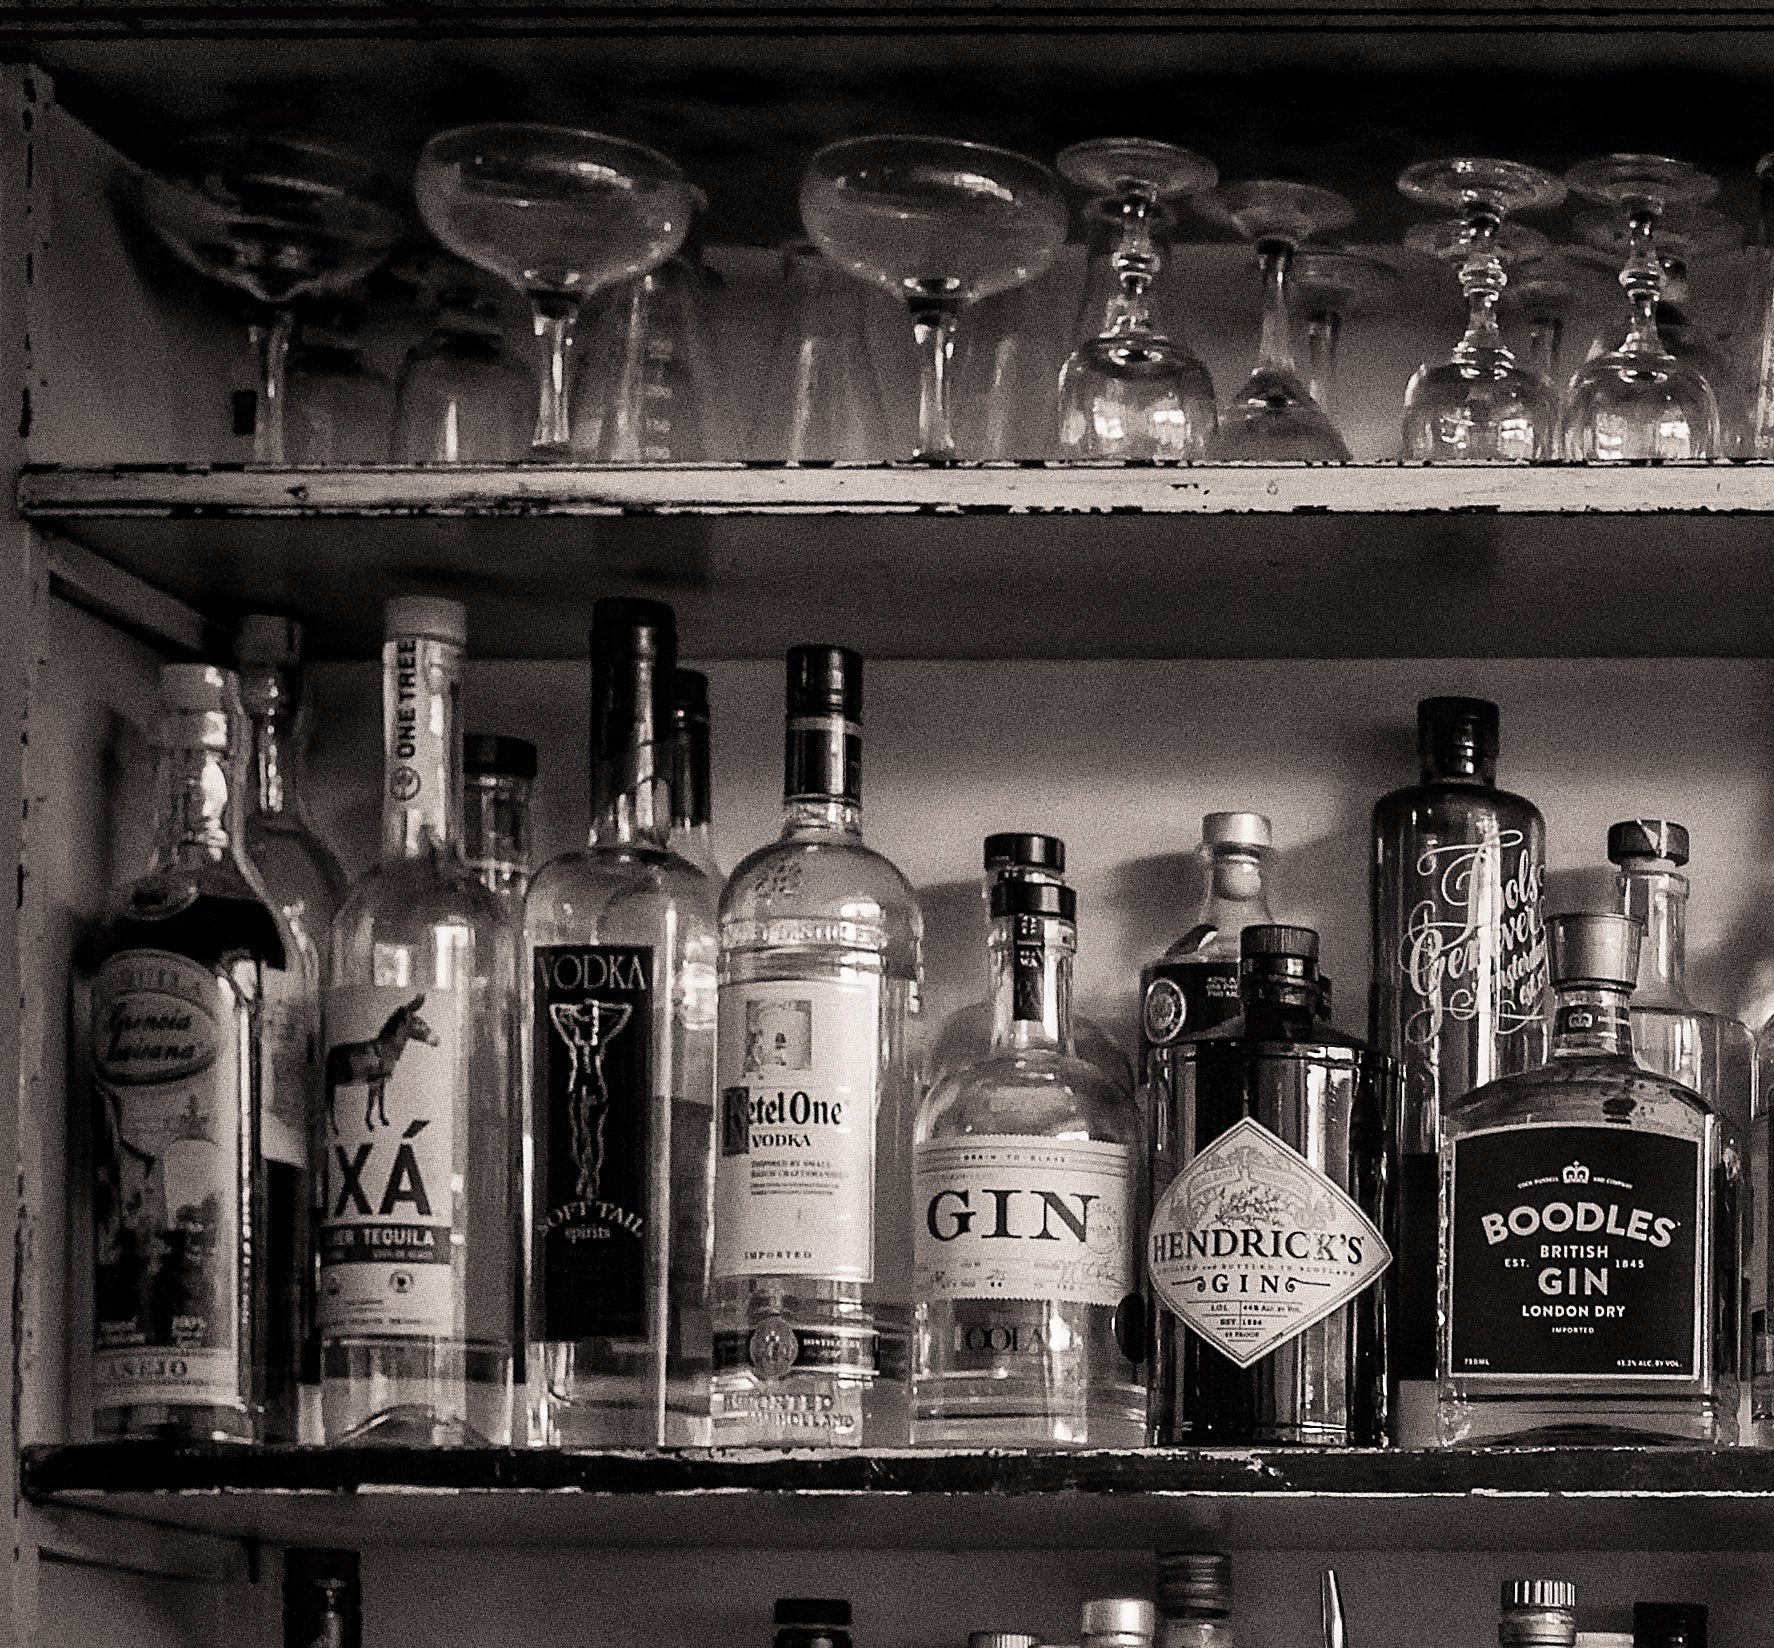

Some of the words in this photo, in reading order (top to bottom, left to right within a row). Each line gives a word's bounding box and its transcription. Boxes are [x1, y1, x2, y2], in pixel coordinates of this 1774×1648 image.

[398, 708, 416, 758] ONE
[539, 954, 646, 990] VODKA
[789, 1091, 842, 1125] One
[752, 1135, 812, 1148] VODKA
[335, 1120, 433, 1216] XÁ
[597, 1202, 643, 1237] TAIL
[928, 1188, 1099, 1242] GIN
[1482, 1202, 1677, 1248] BOODLES
[364, 1229, 434, 1246] TEQUILA
[1153, 1227, 1364, 1264] HENDRICK'S
[1540, 1246, 1608, 1258] BRITISH
[1505, 1259, 1529, 1267] EST.
[1615, 1259, 1645, 1268] 1845
[1212, 1274, 1280, 1292] GIN
[1538, 1267, 1608, 1295] GIN
[1522, 1305, 1589, 1317] LONDON
[1595, 1306, 1625, 1317] DRY
